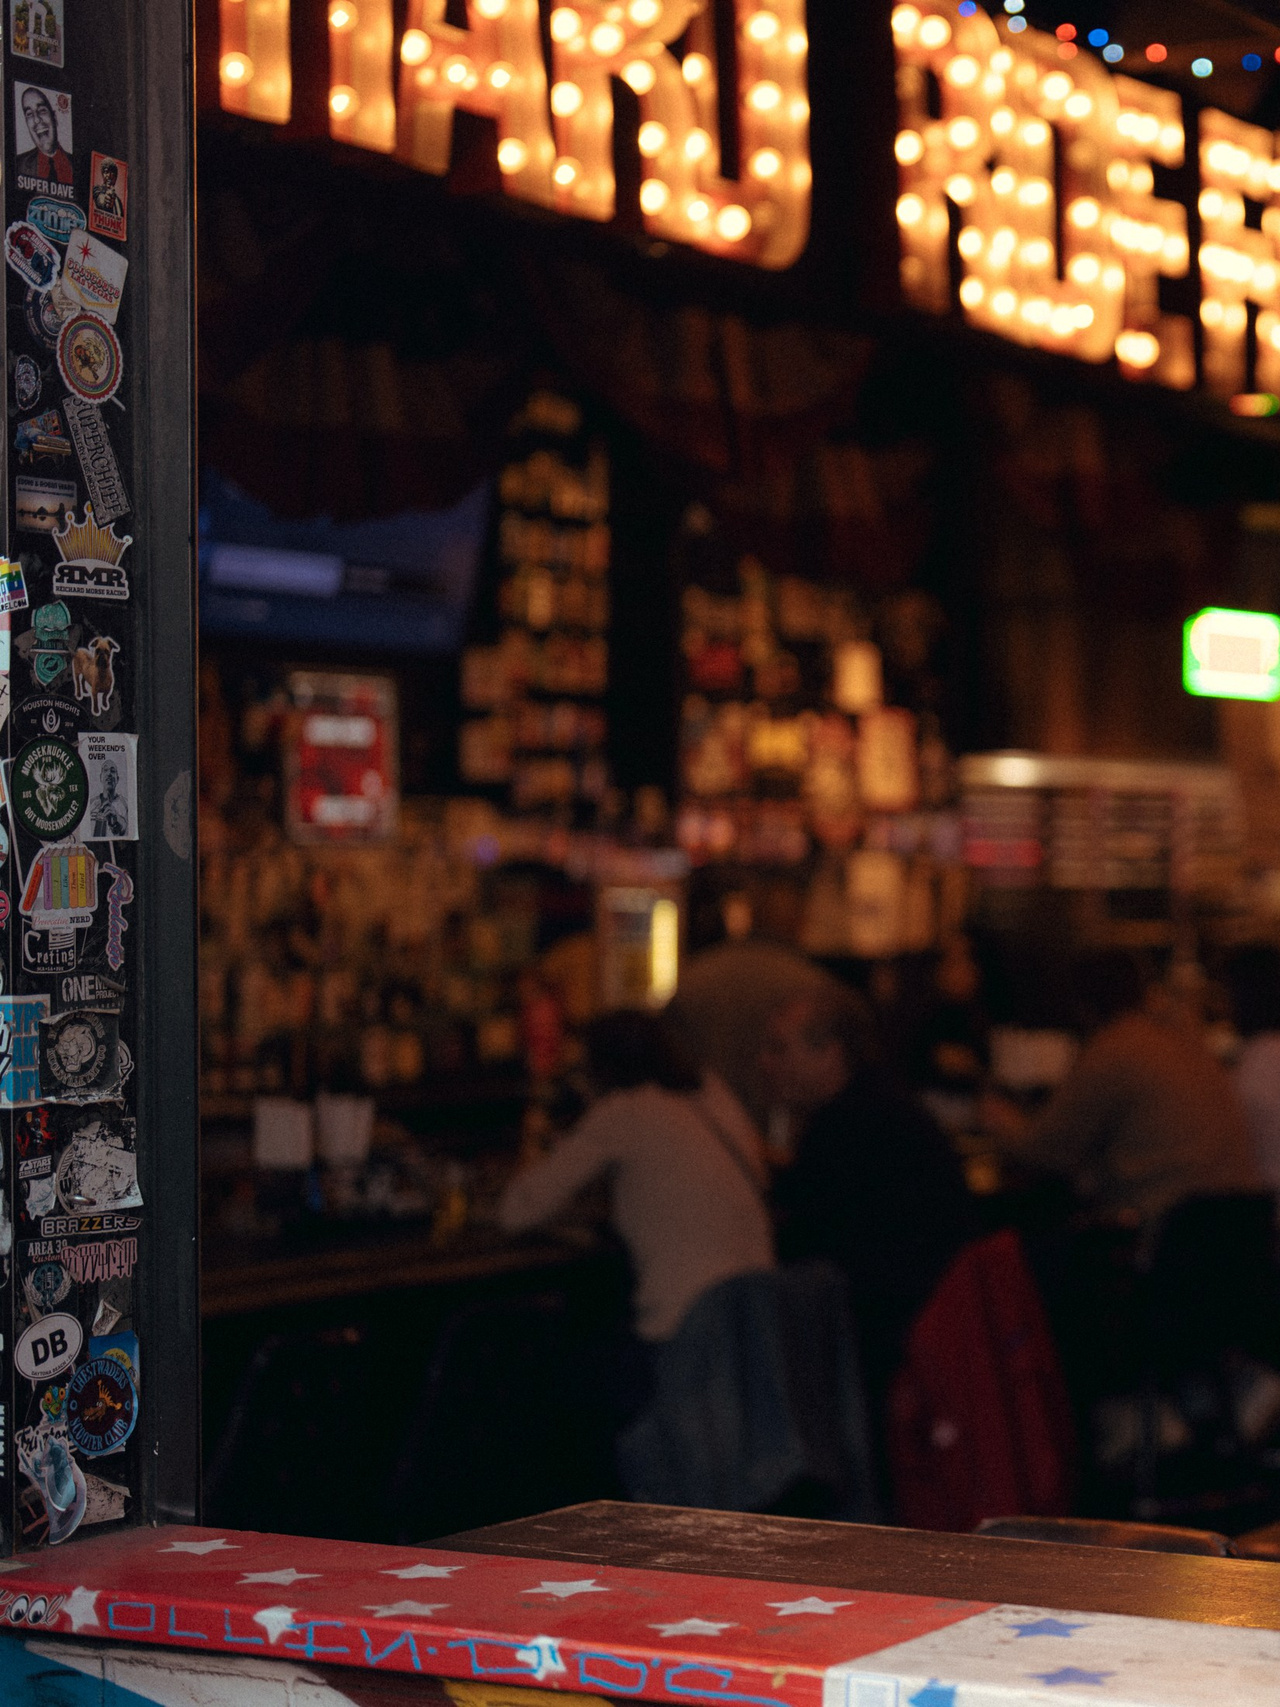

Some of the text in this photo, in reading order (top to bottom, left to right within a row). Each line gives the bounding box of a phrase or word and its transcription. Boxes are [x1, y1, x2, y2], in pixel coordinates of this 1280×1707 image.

[18, 175, 75, 199] SUPER DAVE
[31, 233, 50, 253] SAVAGE
[71, 272, 86, 287] LAS
[87, 281, 113, 304] VEGAS
[23, 700, 80, 716] HOUSTON HEIGHTS
[88, 744, 125, 752] WEEKEND'S
[88, 753, 106, 761] OVER
[20, 745, 75, 776] MOOSEKNUCKLE
[69, 915, 91, 924] NERD
[24, 930, 74, 965] Cretins
[61, 975, 95, 1002] ONE
[44, 1216, 140, 1234] BRAZZERS
[28, 1240, 54, 1257] AREA
[31, 1328, 68, 1367] DB
[70, 1416, 103, 1450] SCOOTER
[104, 1418, 128, 1446] CLUB
